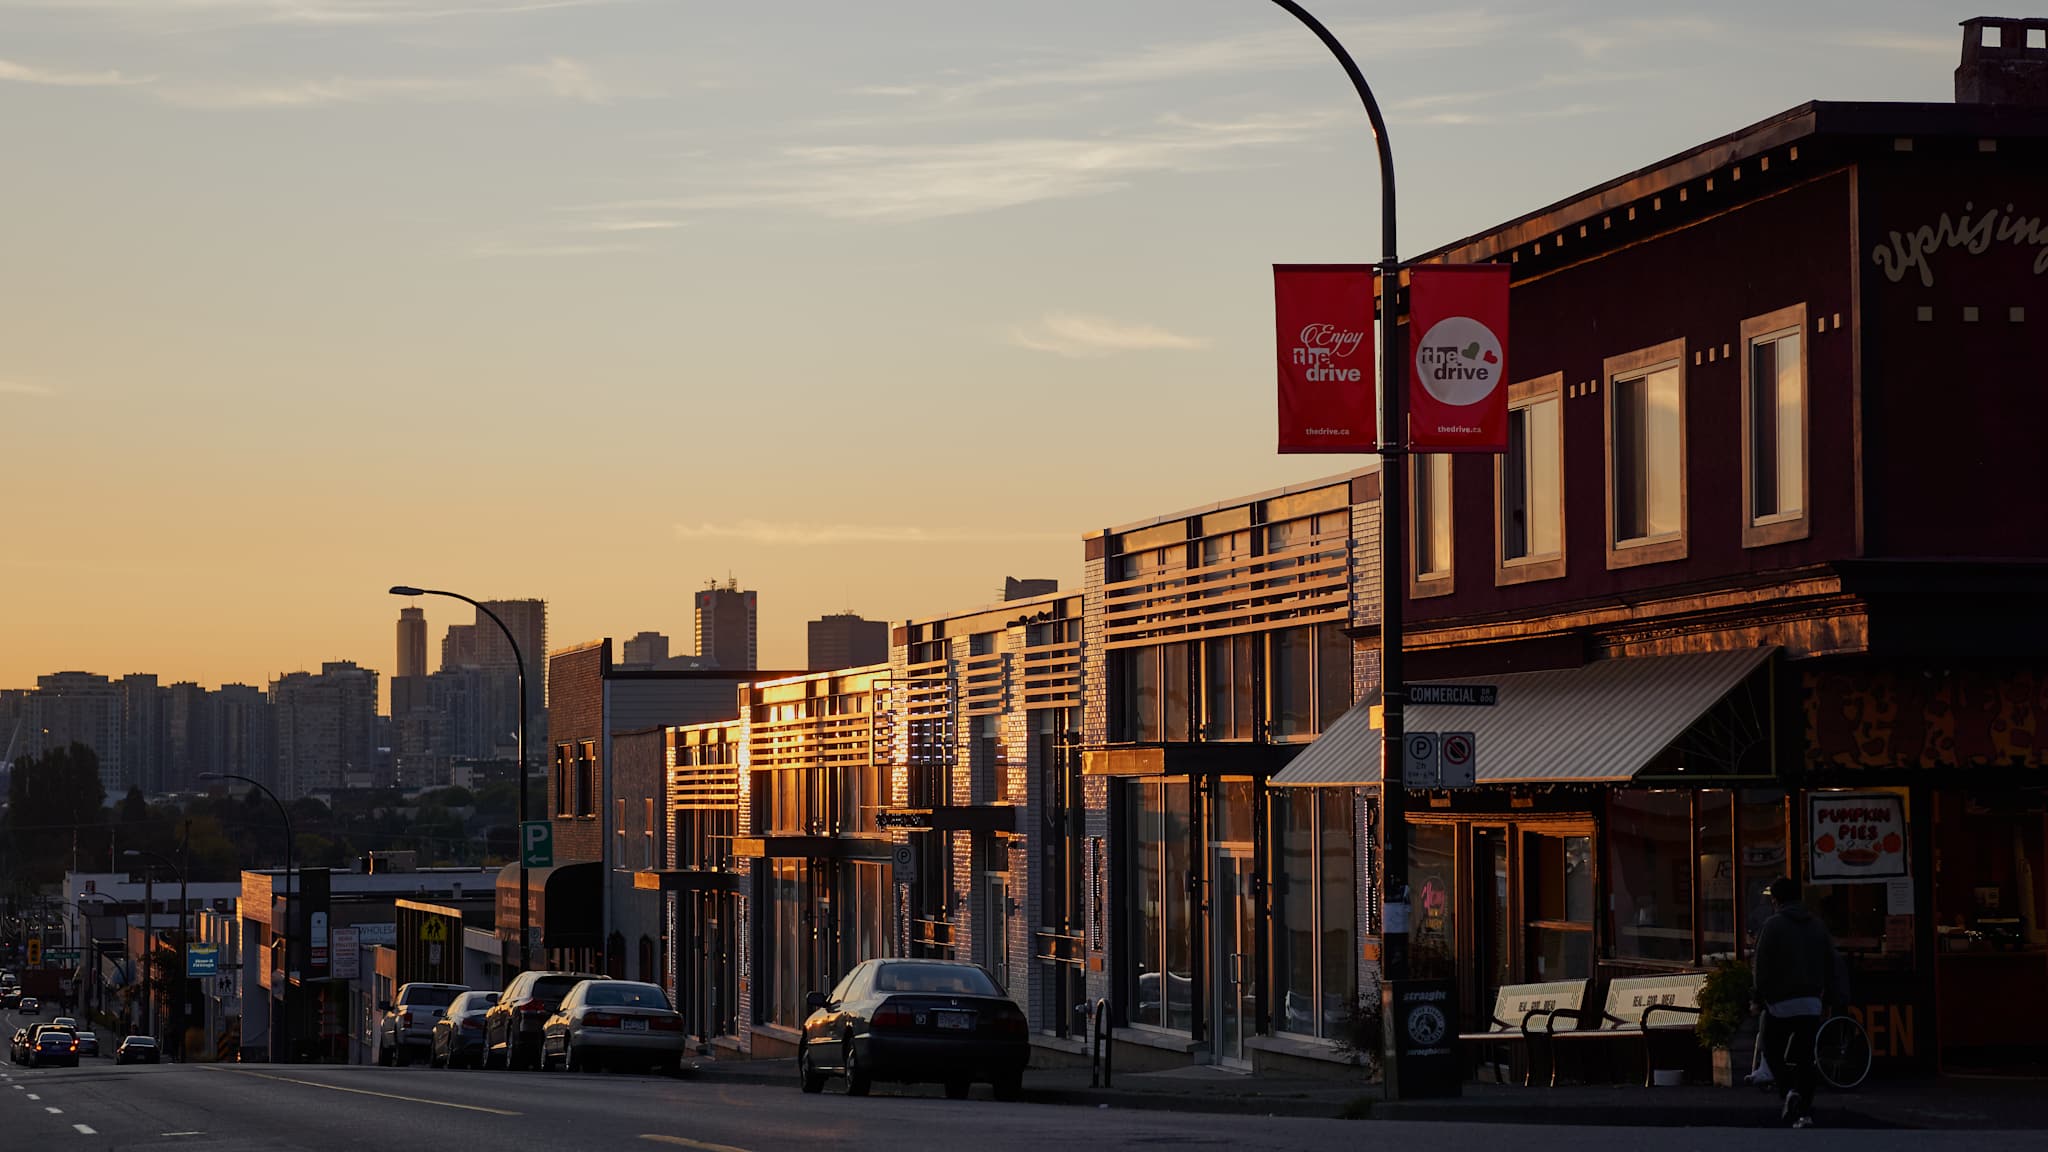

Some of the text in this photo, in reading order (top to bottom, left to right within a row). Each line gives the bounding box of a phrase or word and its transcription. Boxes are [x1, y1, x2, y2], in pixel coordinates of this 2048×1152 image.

[1300, 323, 1364, 358] Enjoy
[1293, 347, 1330, 365] the
[1422, 346, 1458, 364] the
[1305, 363, 1361, 382] drive
[1434, 362, 1489, 380] drive
[1305, 427, 1350, 436] thedrive.ca
[1437, 425, 1482, 433] thedrive.ca
[1411, 687, 1475, 703] COMMERCIAL
[1416, 741, 1427, 755] P
[1817, 807, 1891, 824] PUMPKIN
[526, 824, 549, 851] P
[1838, 824, 1878, 840] PIES
